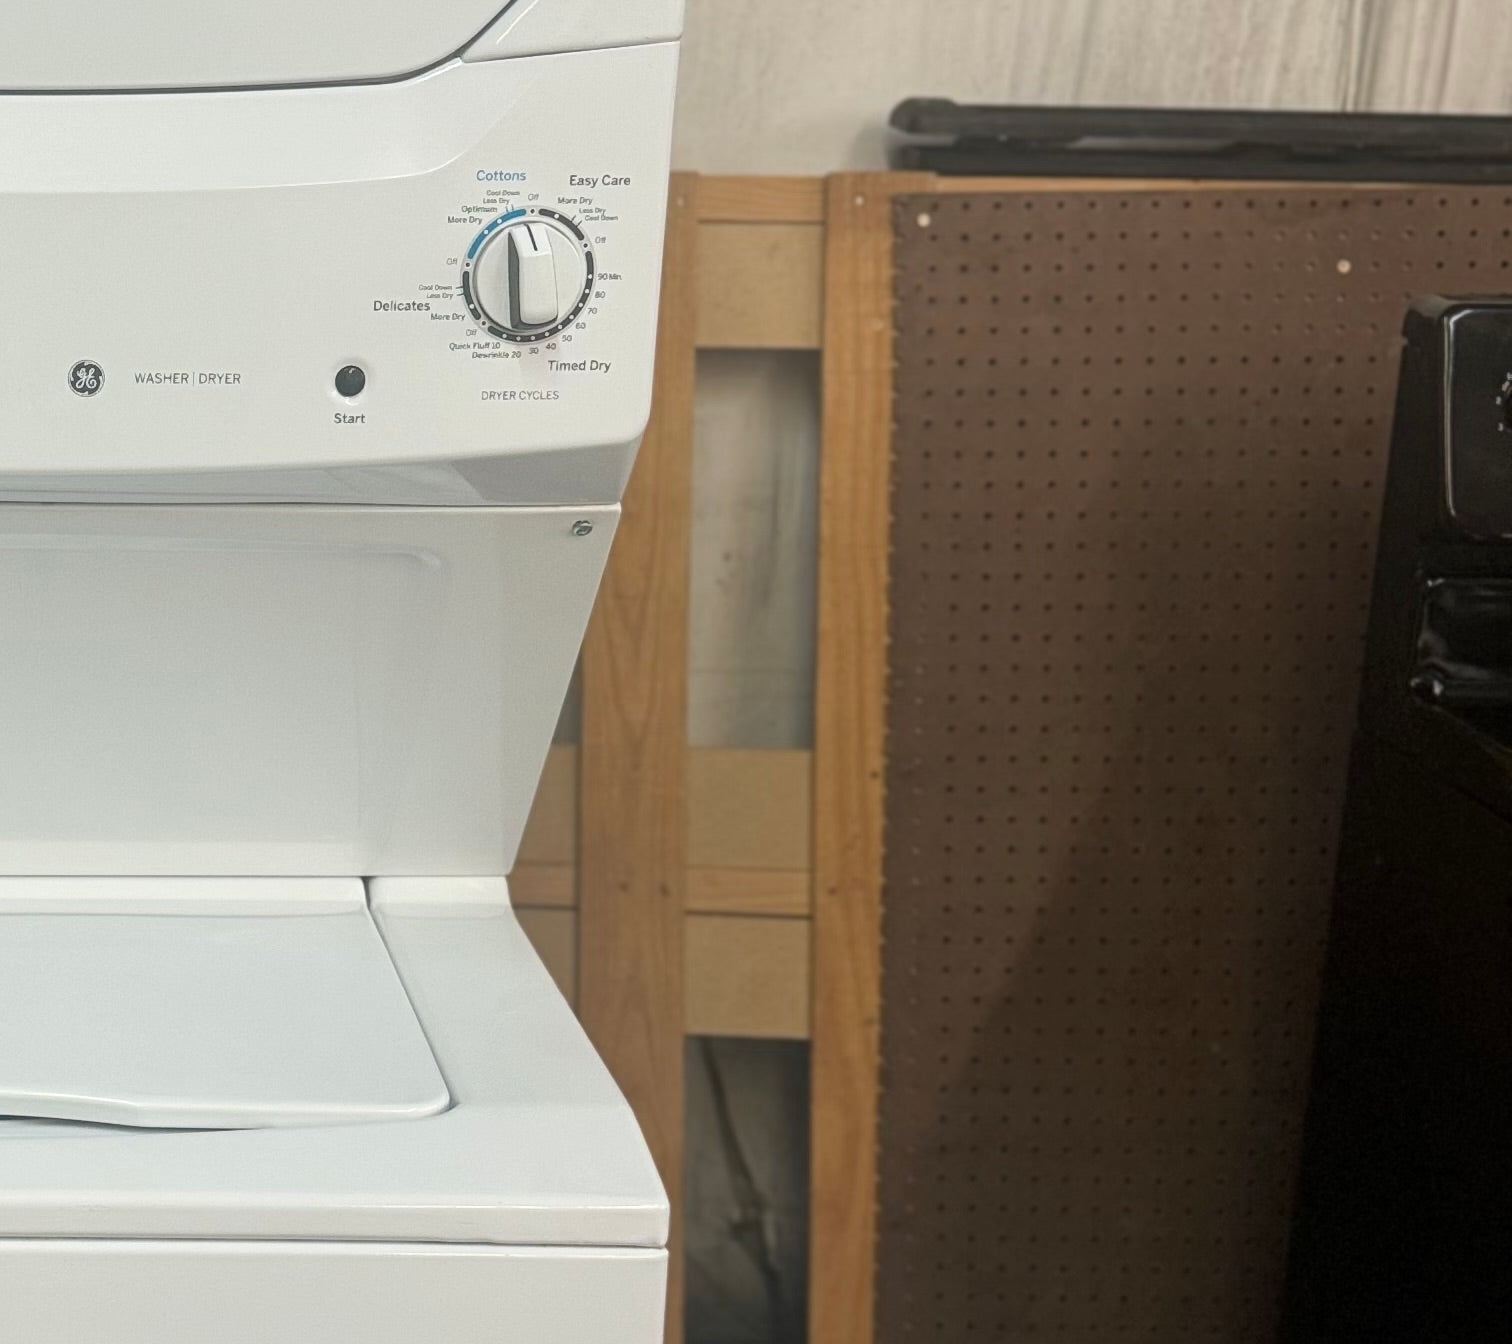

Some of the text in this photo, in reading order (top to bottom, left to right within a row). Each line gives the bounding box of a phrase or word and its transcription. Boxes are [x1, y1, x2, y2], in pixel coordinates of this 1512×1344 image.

[476, 169, 527, 181] Cottons
[569, 174, 631, 189] Easy Care
[528, 193, 539, 201] Off
[557, 196, 593, 205] More Dry
[448, 216, 483, 225] More Dry
[594, 236, 606, 244] Off
[595, 291, 605, 299] 80
[373, 300, 431, 312] Delicates
[588, 307, 598, 315] 70
[430, 313, 466, 321] More Dry
[575, 322, 586, 330] 60
[562, 334, 573, 342] 50
[472, 342, 491, 350] Fluff
[492, 341, 501, 350] 10
[545, 342, 557, 350] 40
[511, 350, 522, 359] 20
[528, 347, 539, 355] 30
[548, 359, 612, 373] Timed Dry
[134, 372, 241, 384] WASHER DRYER
[481, 391, 560, 401] DRYER CYCLES
[334, 412, 366, 424] Start
